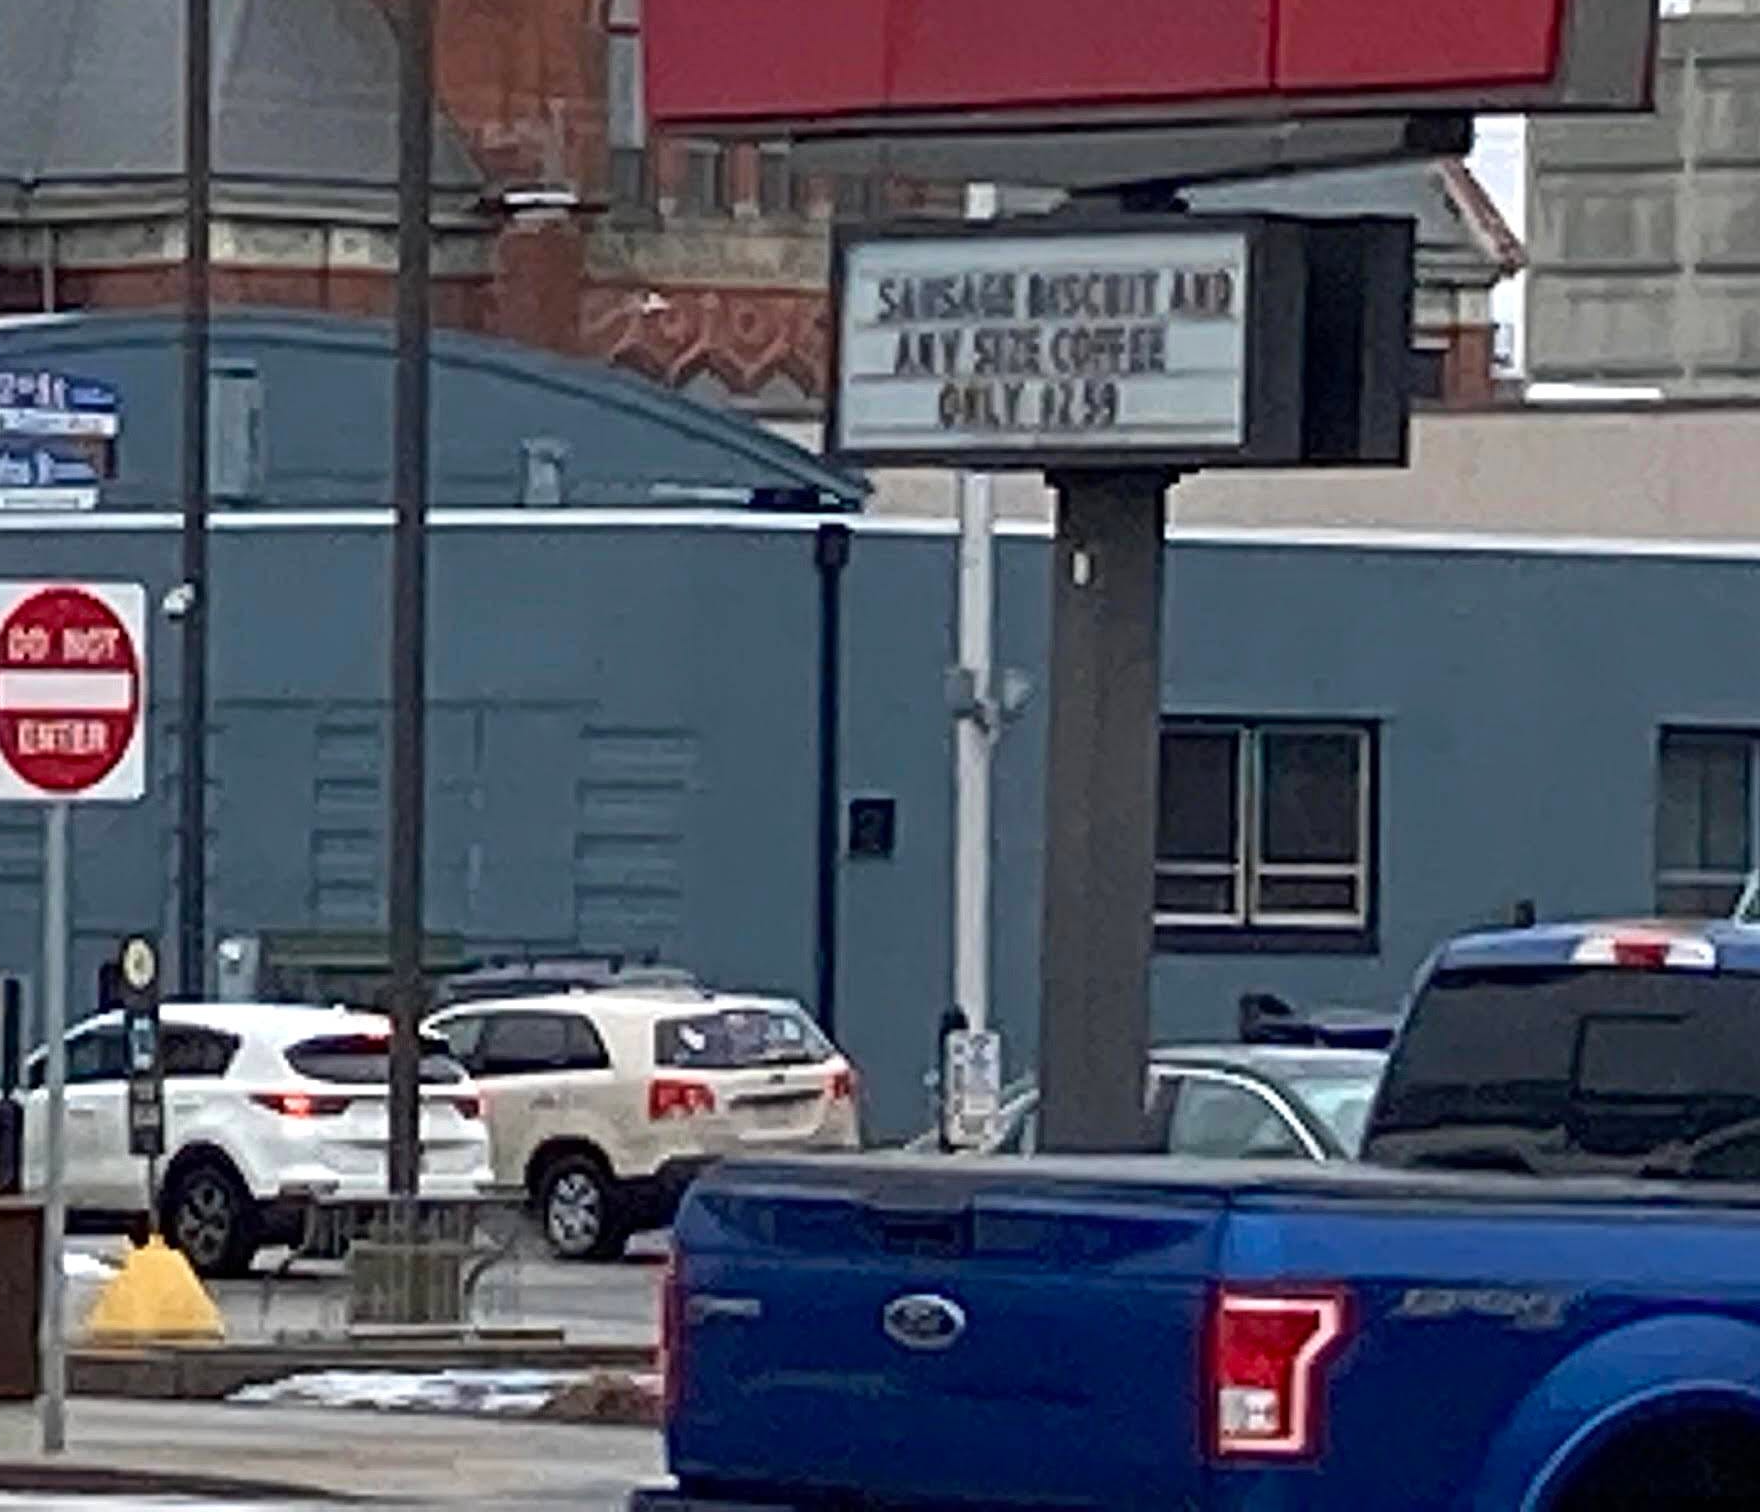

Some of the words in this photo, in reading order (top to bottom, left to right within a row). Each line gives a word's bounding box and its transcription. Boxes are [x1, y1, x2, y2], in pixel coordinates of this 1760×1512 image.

[876, 273, 1016, 321] SAUSAGE
[1028, 270, 1160, 319] BISCUIT
[1170, 268, 1234, 315] AND
[893, 327, 961, 376] ANY
[973, 326, 1041, 375] SIZE
[1050, 325, 1168, 374] COFFEE
[938, 380, 1025, 428] ONLY
[8, 626, 50, 662] DO
[62, 625, 120, 662] NOT
[17, 719, 107, 754] ENTER
